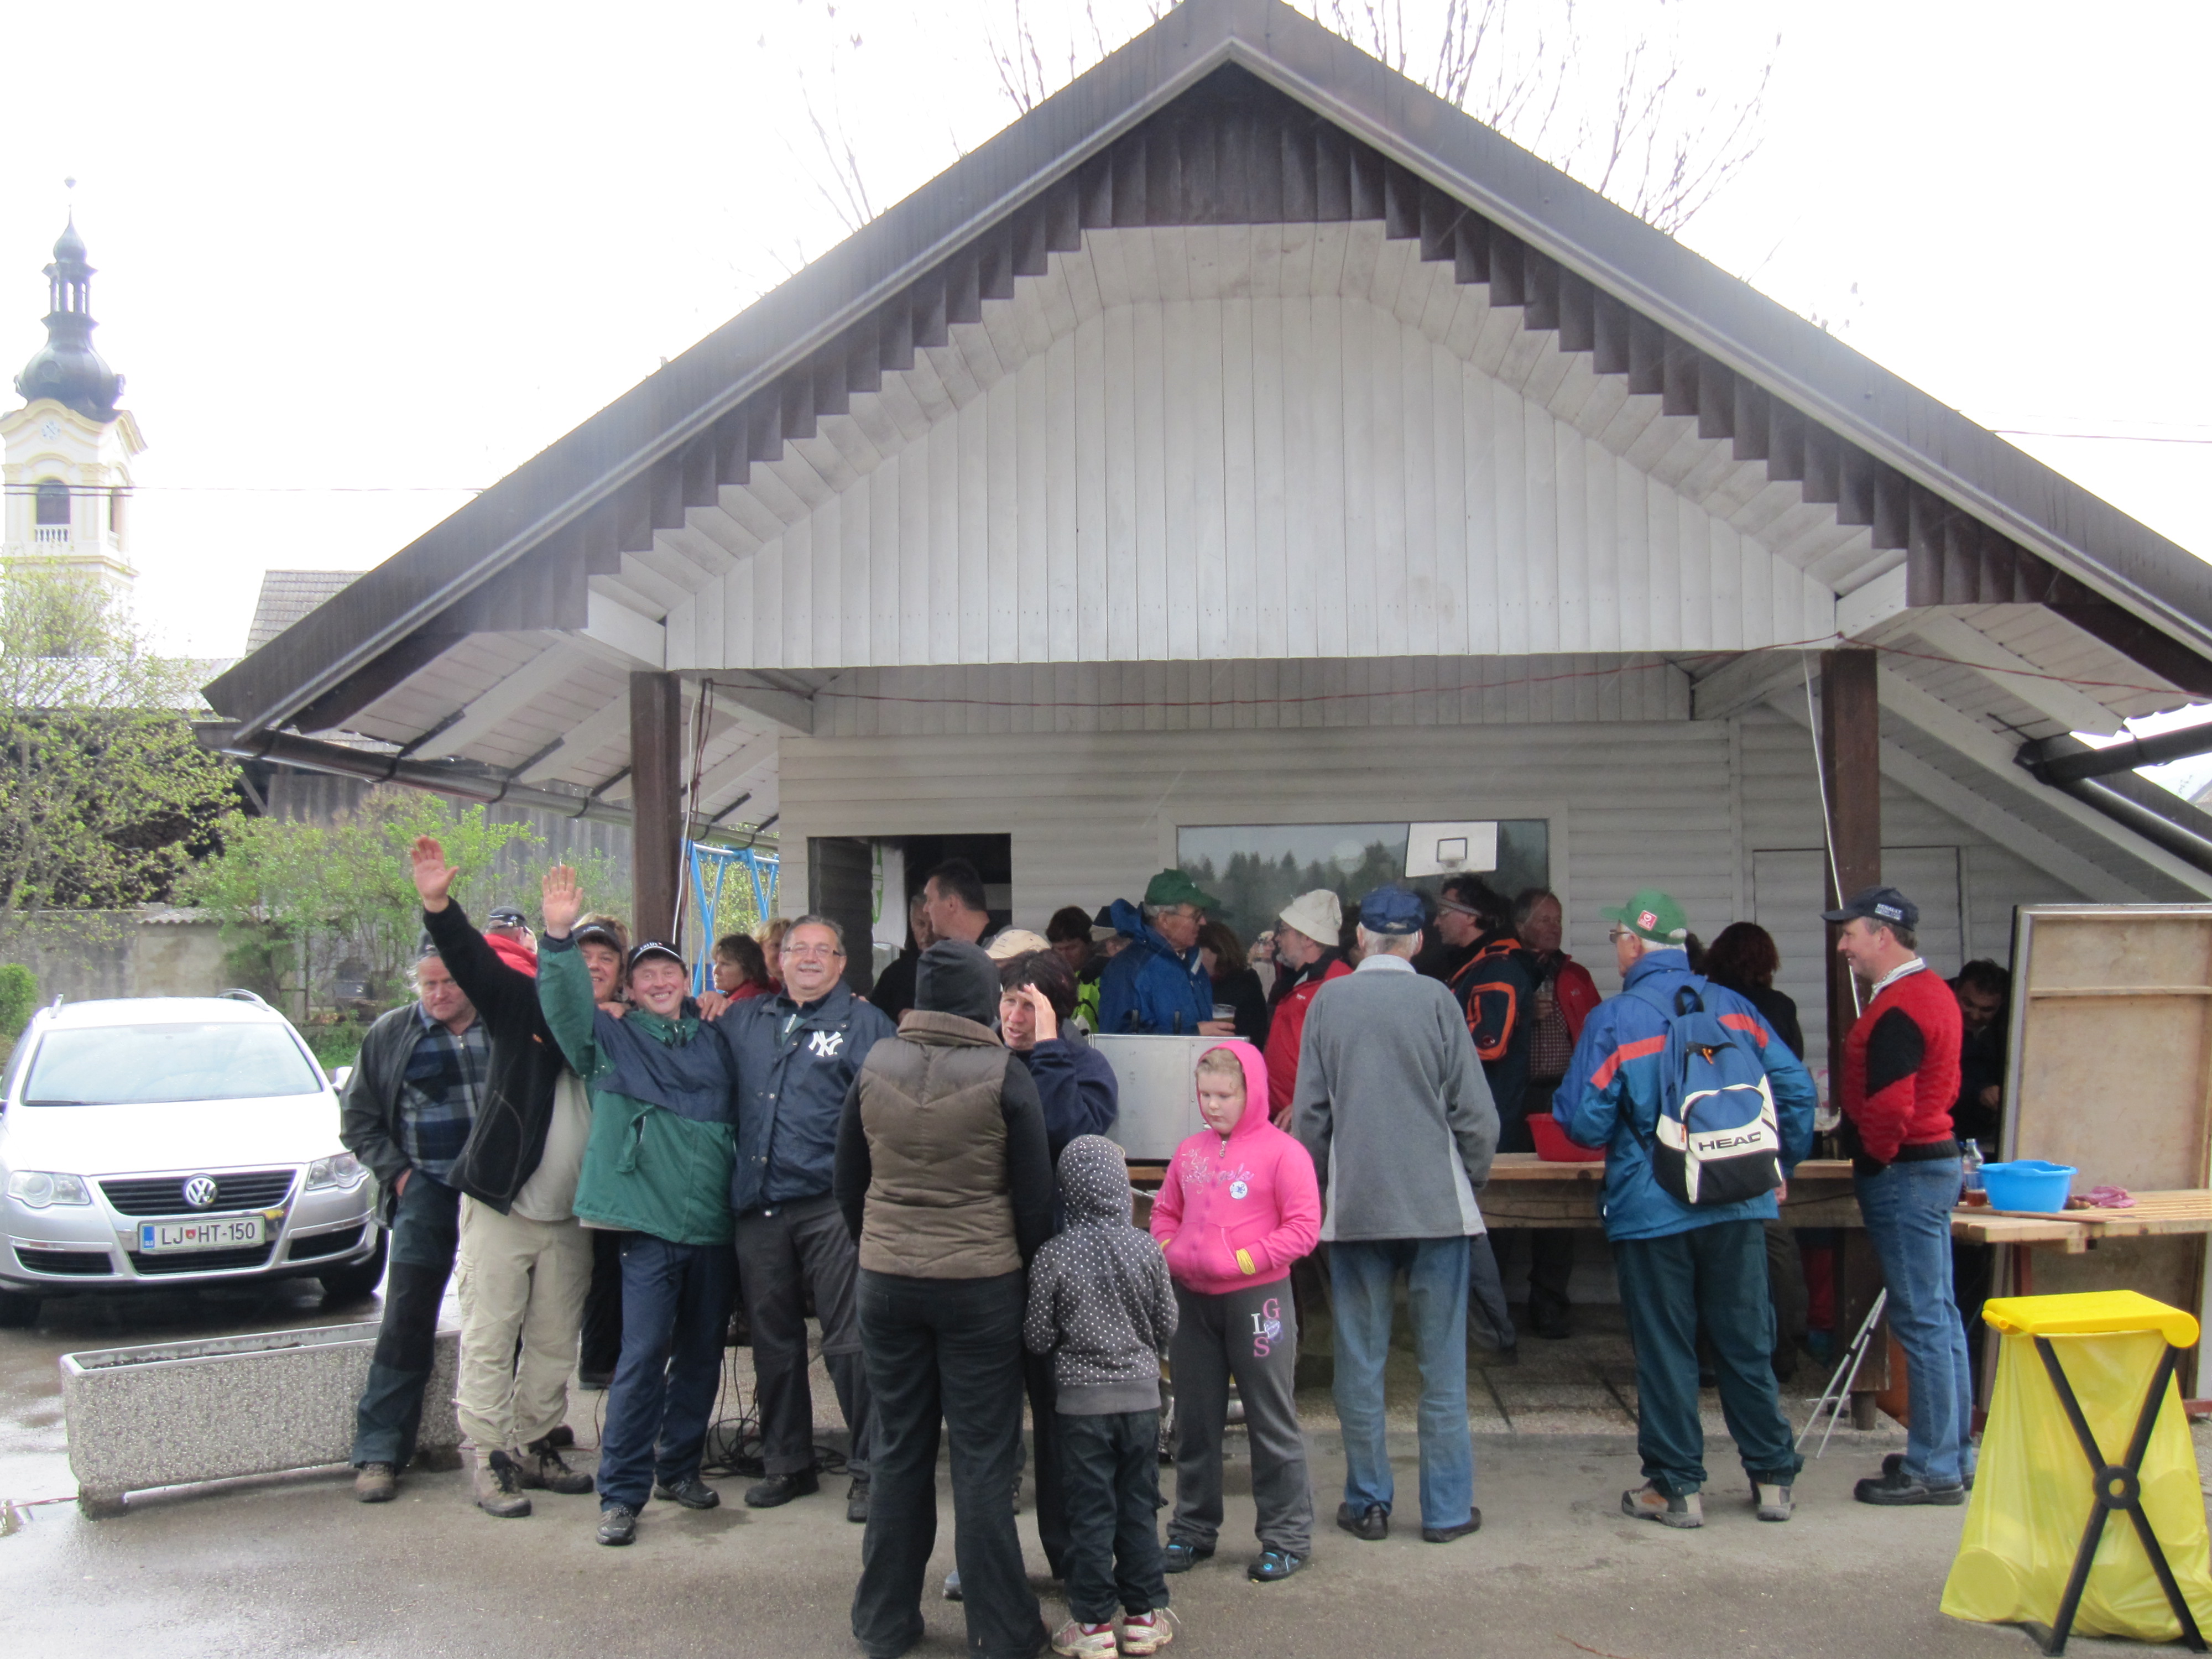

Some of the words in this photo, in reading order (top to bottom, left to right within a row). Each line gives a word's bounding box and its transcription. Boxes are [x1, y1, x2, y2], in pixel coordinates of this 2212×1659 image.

[1877, 903, 1902, 914] RENAULT
[1698, 1131, 1761, 1151] HEAD
[161, 1227, 183, 1245] LJ
[198, 1222, 255, 1243] HT-150
